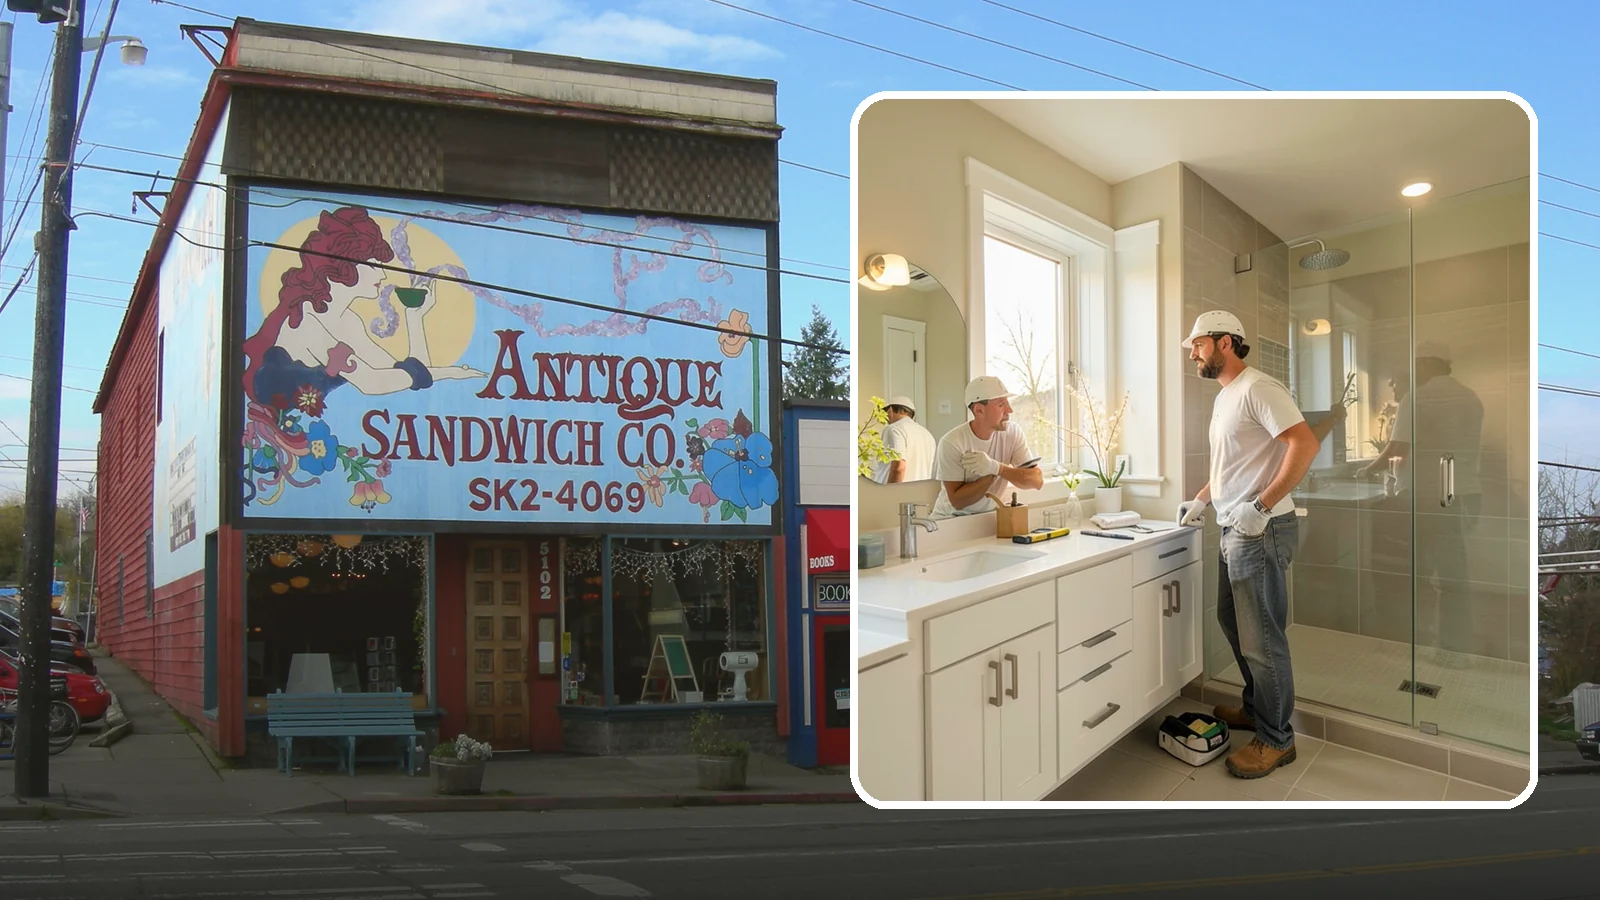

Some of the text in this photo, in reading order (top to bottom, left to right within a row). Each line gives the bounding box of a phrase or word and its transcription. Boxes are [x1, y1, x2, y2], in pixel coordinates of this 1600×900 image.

[475, 329, 723, 420] ANTIQUE
[361, 409, 684, 469] SANDWICH CO.
[469, 477, 646, 513] SK2-4069
[539, 542, 552, 600] 5102
[809, 555, 835, 569] BOOKS
